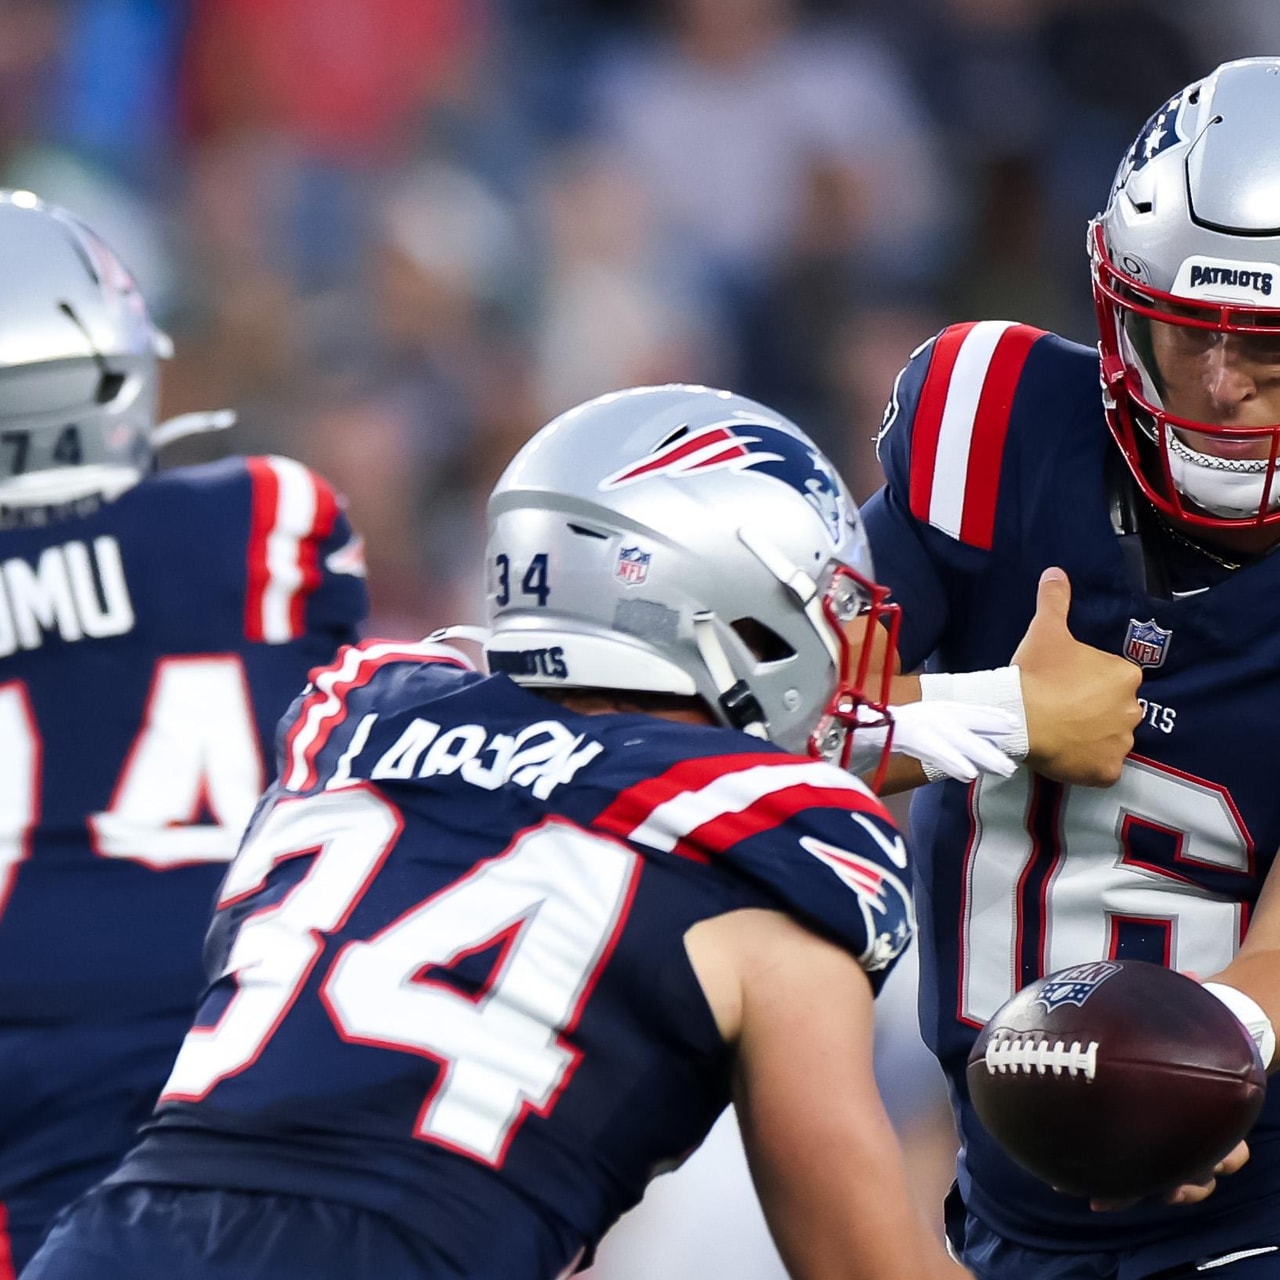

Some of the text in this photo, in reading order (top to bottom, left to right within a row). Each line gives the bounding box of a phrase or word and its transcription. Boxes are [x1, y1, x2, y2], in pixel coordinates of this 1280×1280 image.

[1189, 264, 1273, 296] PATRIOTS
[495, 553, 551, 607] 34
[1128, 640, 1160, 663] NFL
[957, 752, 1257, 1030] 16
[156, 780, 644, 1169] 34
